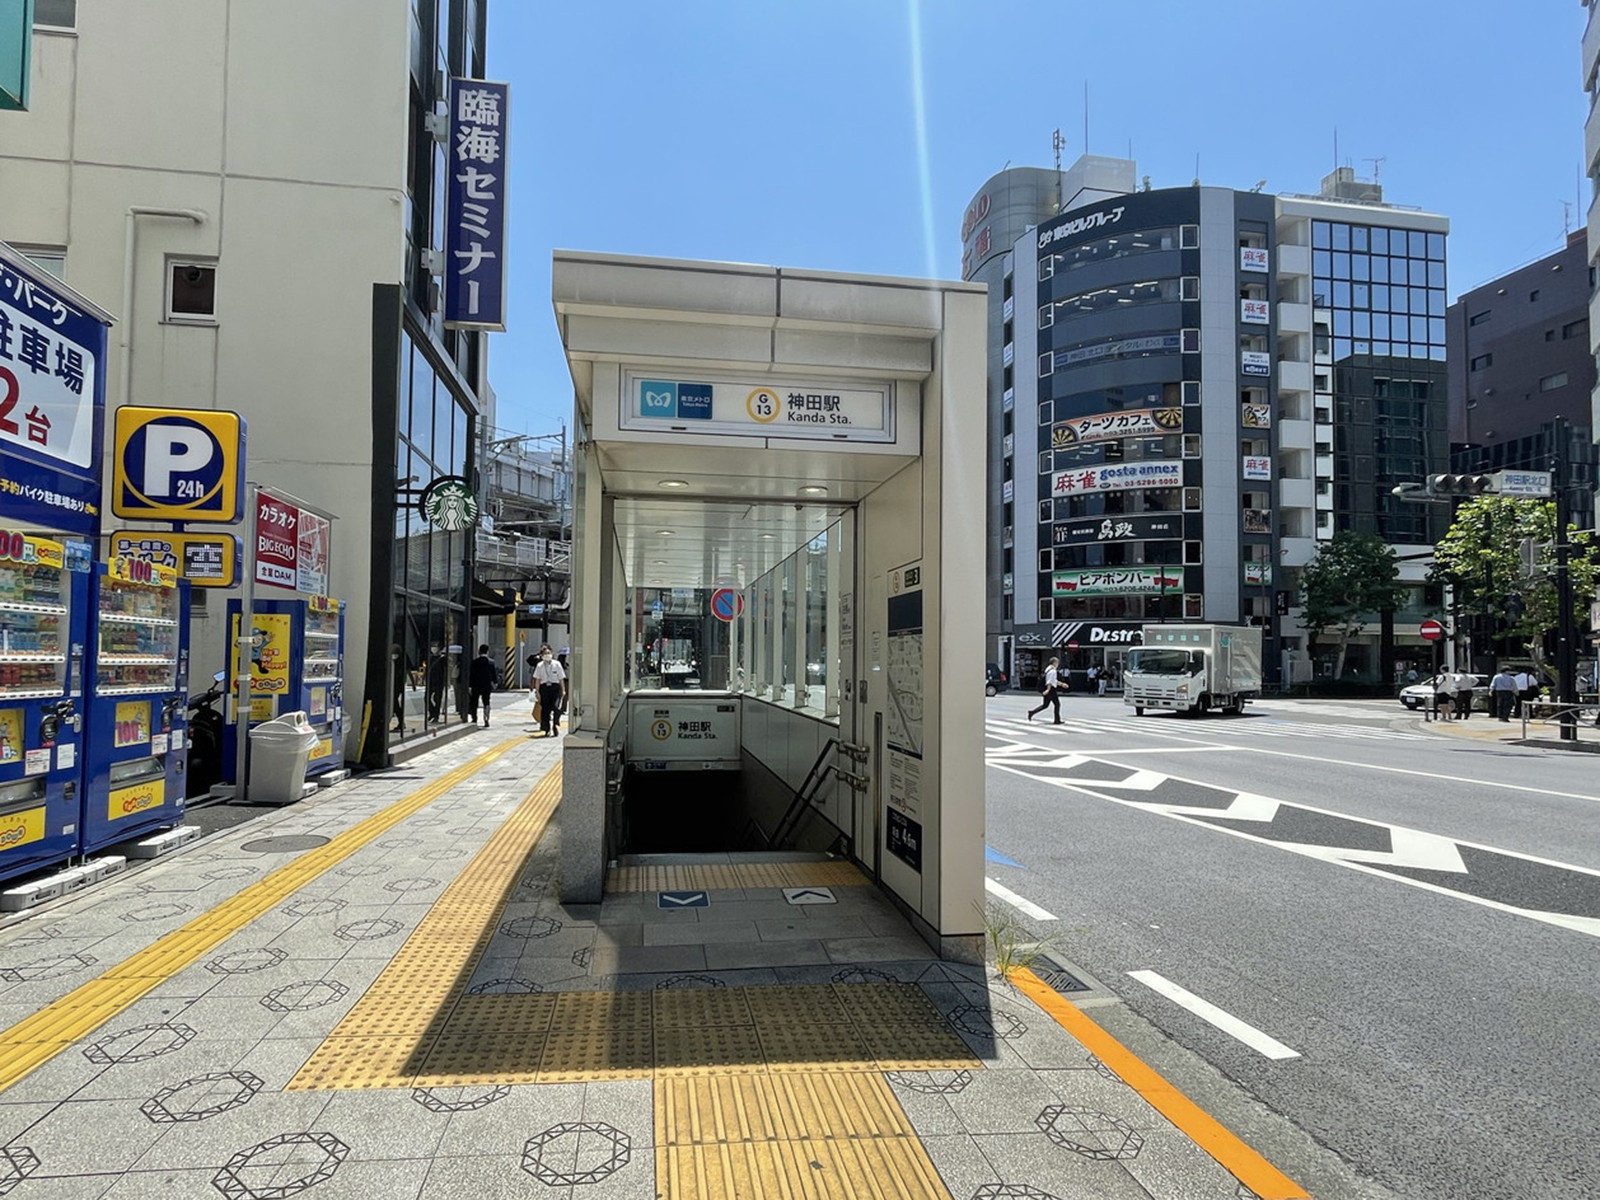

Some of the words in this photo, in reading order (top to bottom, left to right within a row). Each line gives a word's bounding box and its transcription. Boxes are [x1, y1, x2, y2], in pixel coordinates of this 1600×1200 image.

[454, 88, 502, 315] 臨海セミナー
[759, 393, 769, 404] G
[787, 393, 841, 413] 神田駅
[756, 403, 772, 416] 13
[787, 411, 826, 423] Kanda
[829, 413, 852, 425] Sta.
[144, 423, 214, 497] P
[1054, 470, 1097, 492] 麻雀
[1099, 466, 1137, 481] gosta
[1139, 464, 1179, 476] annex
[177, 479, 204, 498] 24h
[260, 503, 297, 530] カラオケ
[258, 535, 275, 552] BIG
[274, 542, 296, 561] ECHO
[678, 721, 712, 732] 神田駅
[678, 732, 702, 740] Kanda
